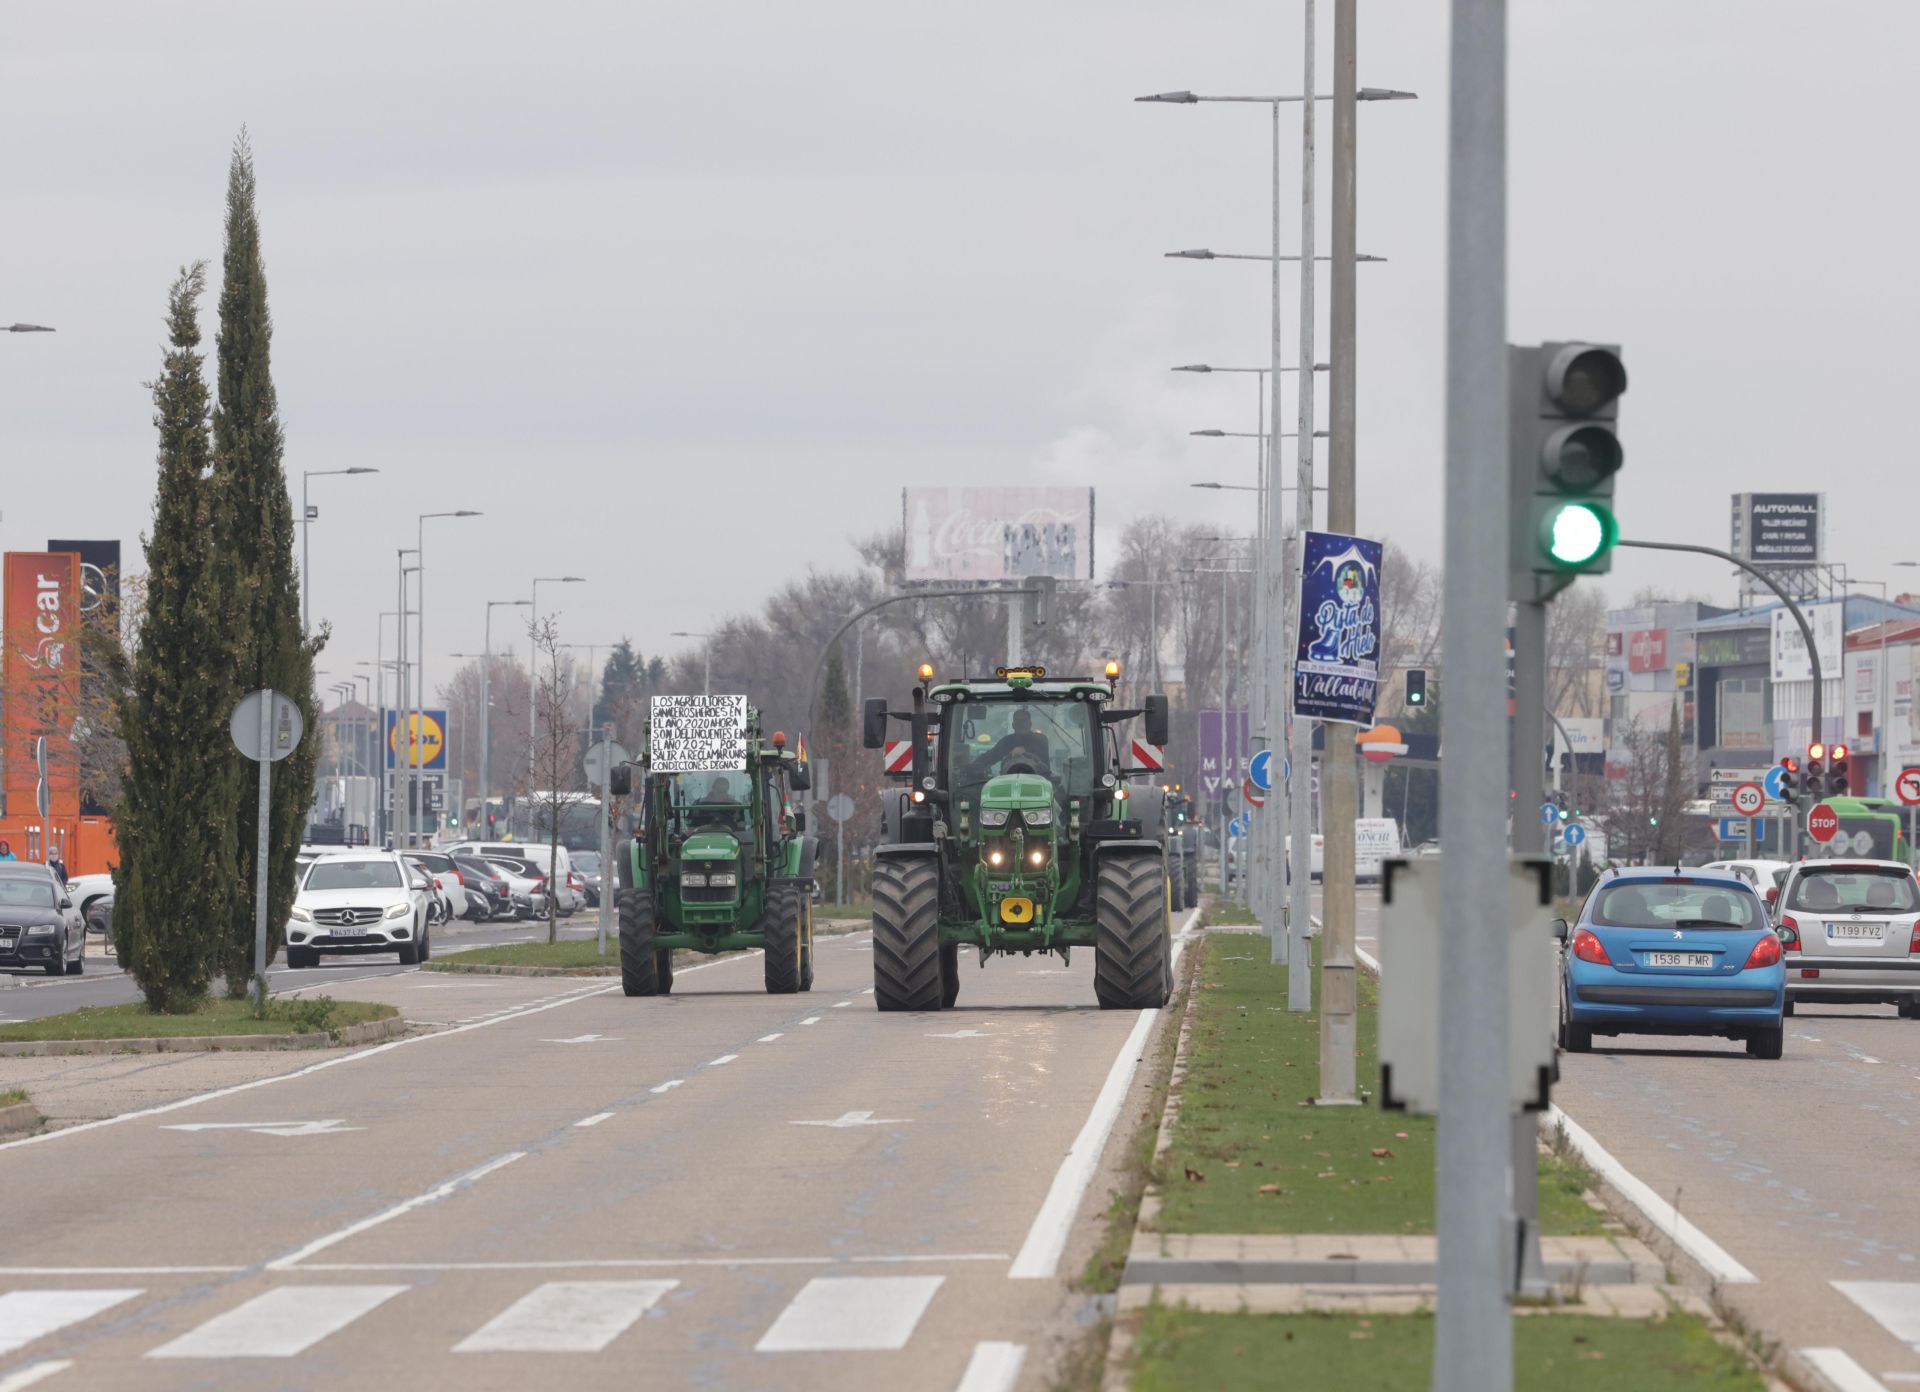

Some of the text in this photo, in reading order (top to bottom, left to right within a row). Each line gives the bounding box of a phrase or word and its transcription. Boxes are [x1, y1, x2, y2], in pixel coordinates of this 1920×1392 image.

[1753, 504, 1817, 513] AUTOVALL
[1315, 597, 1374, 637] Pista de
[1341, 625, 1376, 661] Hielo
[1299, 674, 1375, 702] Valladolid
[653, 696, 742, 707] LOS AGRICULTORES Y
[653, 707, 695, 718] GANADEROS
[730, 706, 742, 717] EN
[653, 718, 739, 729] EL AÑO 2020 AHORA
[653, 728, 747, 740] SON DELINCUENTES EN
[652, 739, 737, 750] EL AÑO 2024 POR
[652, 750, 677, 760] SALIR
[679, 750, 686, 760] A
[687, 749, 729, 760] RECLAMAR
[652, 760, 739, 771] CONDICIONES DIGNAS
[1740, 793, 1757, 804] 50
[1811, 818, 1836, 828] STOP
[1836, 926, 1881, 937] 1199 FVZ
[1654, 954, 1710, 966] 1536 FMR
